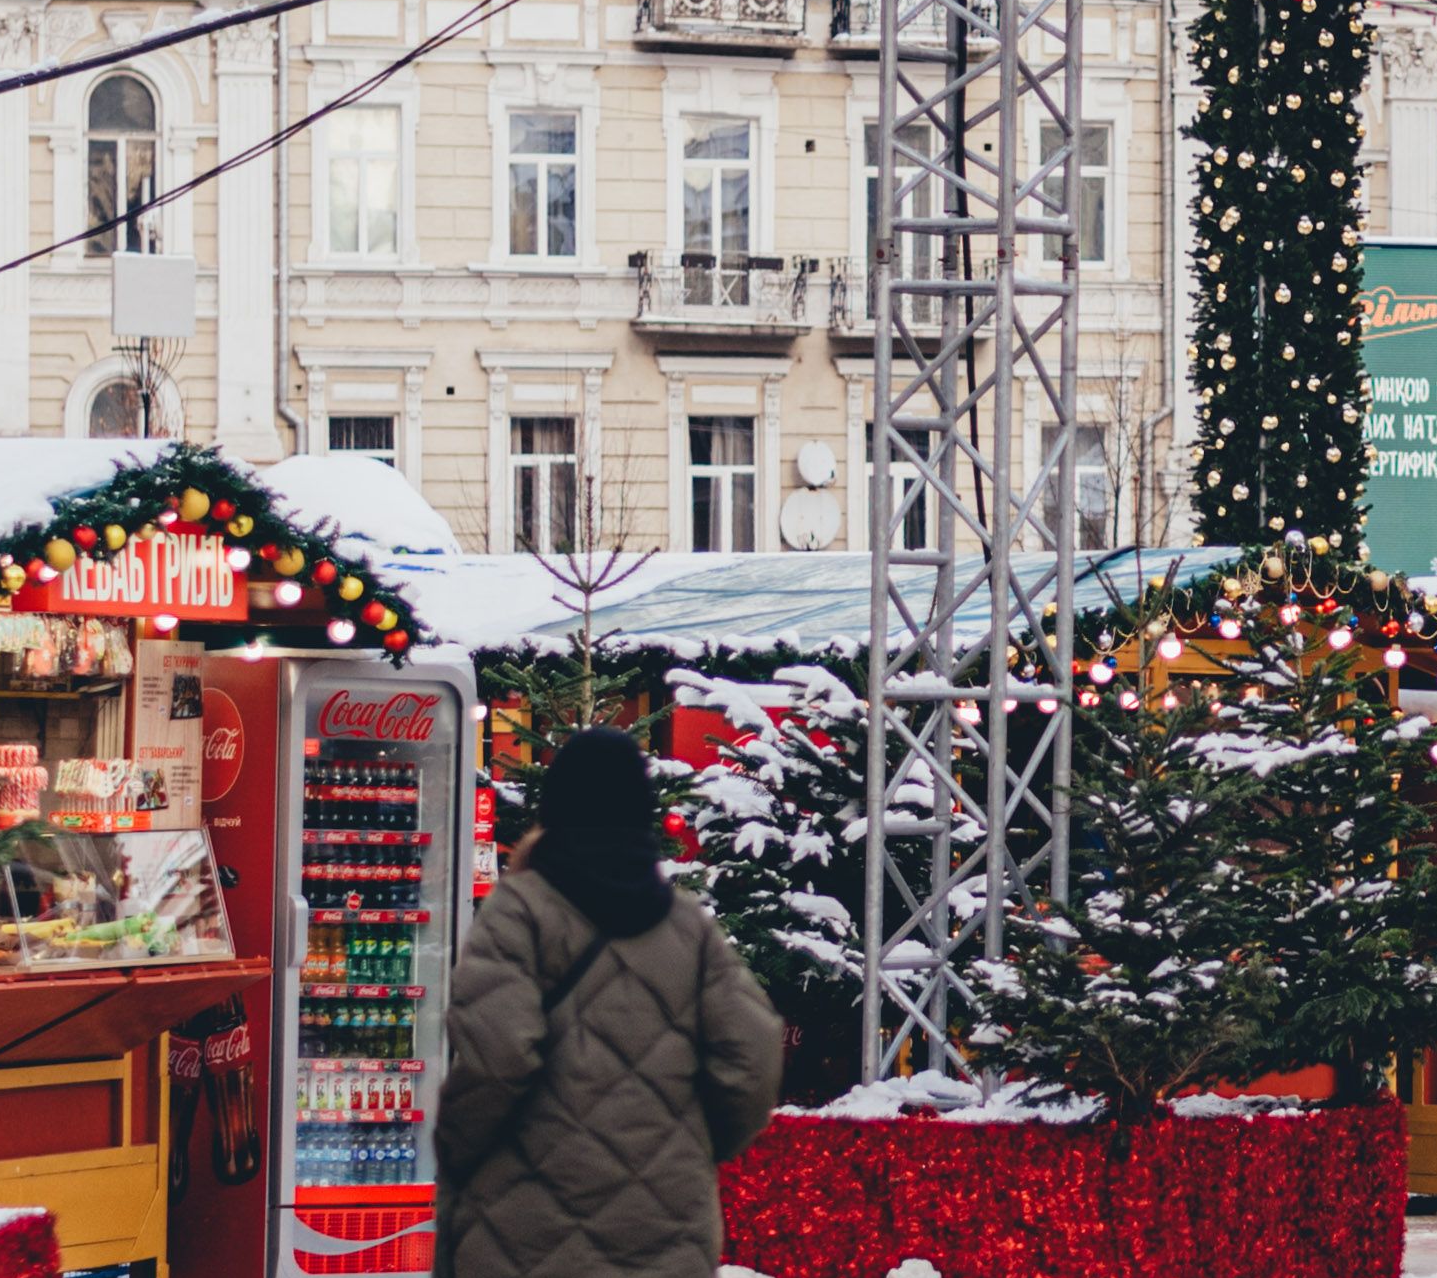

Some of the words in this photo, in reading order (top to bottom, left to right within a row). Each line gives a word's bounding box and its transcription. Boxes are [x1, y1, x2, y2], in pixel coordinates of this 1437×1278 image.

[62, 534, 146, 603] КЕБАБ
[149, 530, 235, 608] ГРИЛЬ
[318, 689, 441, 741] Coca-Cola
